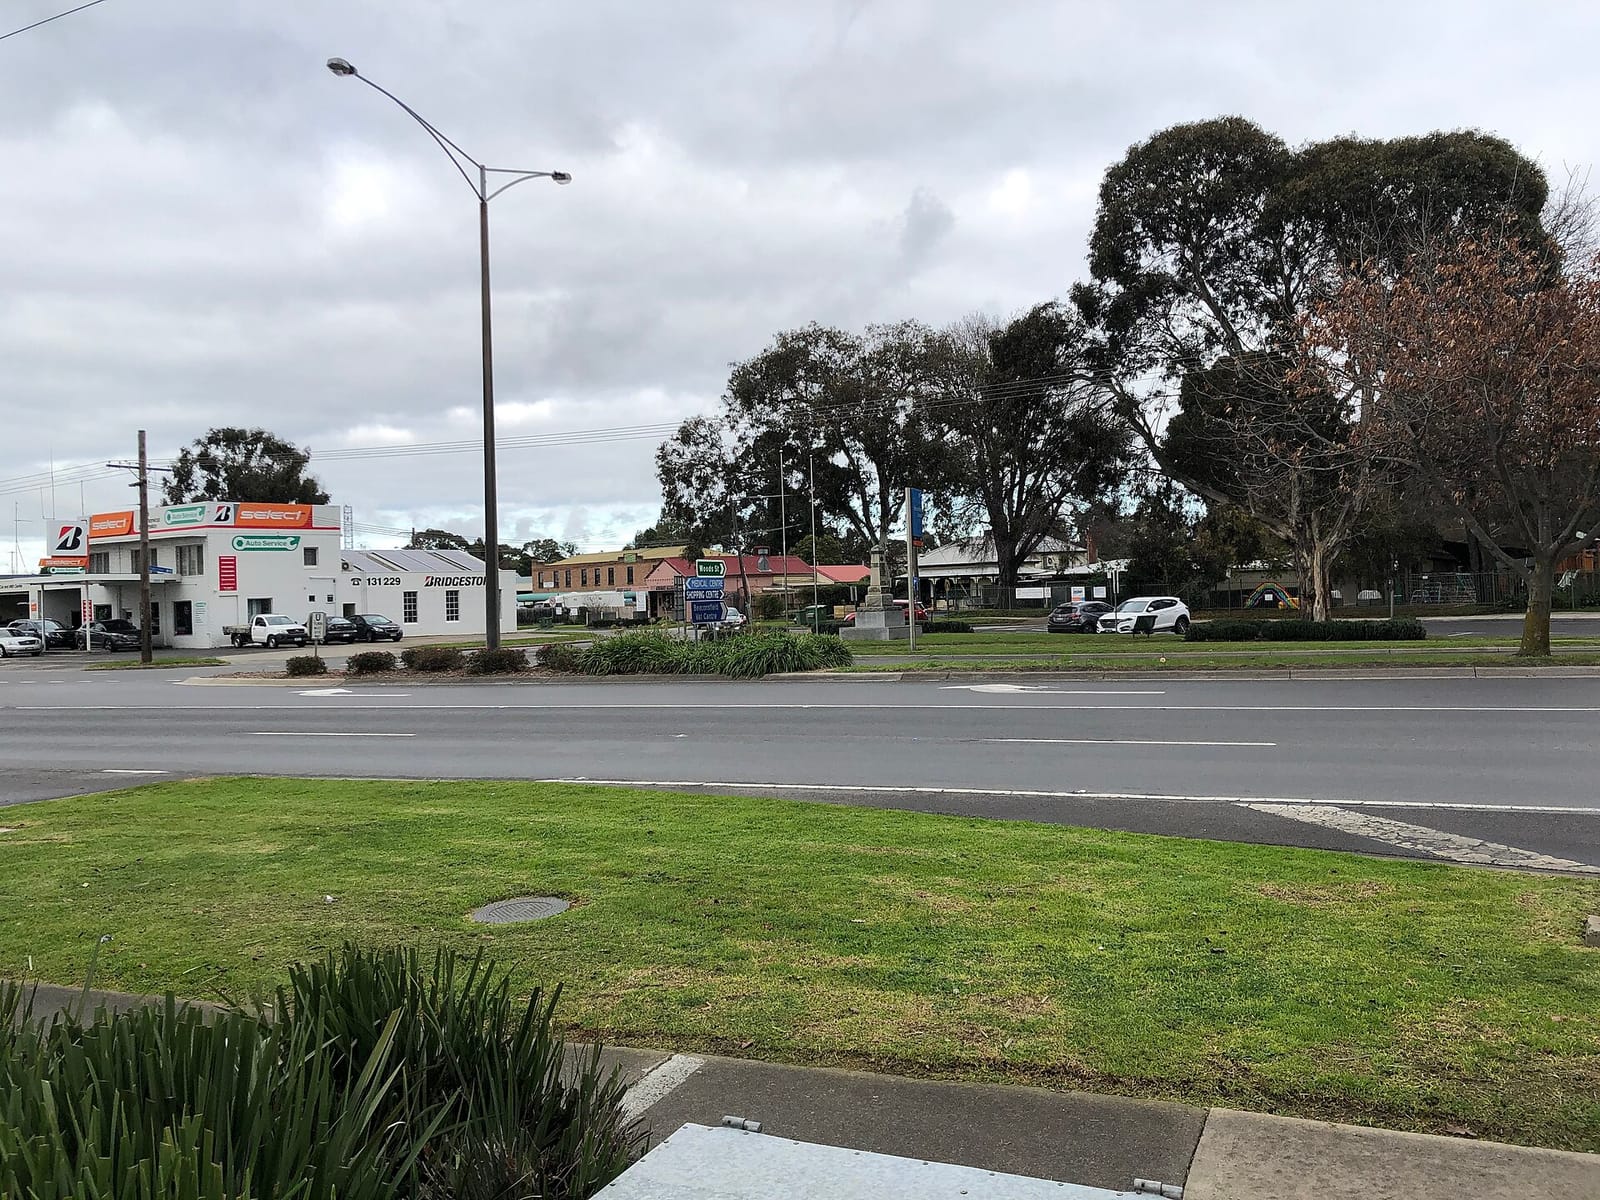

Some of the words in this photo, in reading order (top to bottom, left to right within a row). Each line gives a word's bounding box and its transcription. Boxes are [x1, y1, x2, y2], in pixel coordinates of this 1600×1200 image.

[240, 510, 302, 520] select
[92, 518, 126, 530] select
[700, 564, 714, 572] Woods
[714, 564, 720, 572] St
[366, 577, 382, 586] 131
[383, 577, 400, 586] 229
[691, 580, 708, 588] MEDICAL
[686, 590, 704, 599] SHOPPING
[706, 590, 719, 599] CENTRE
